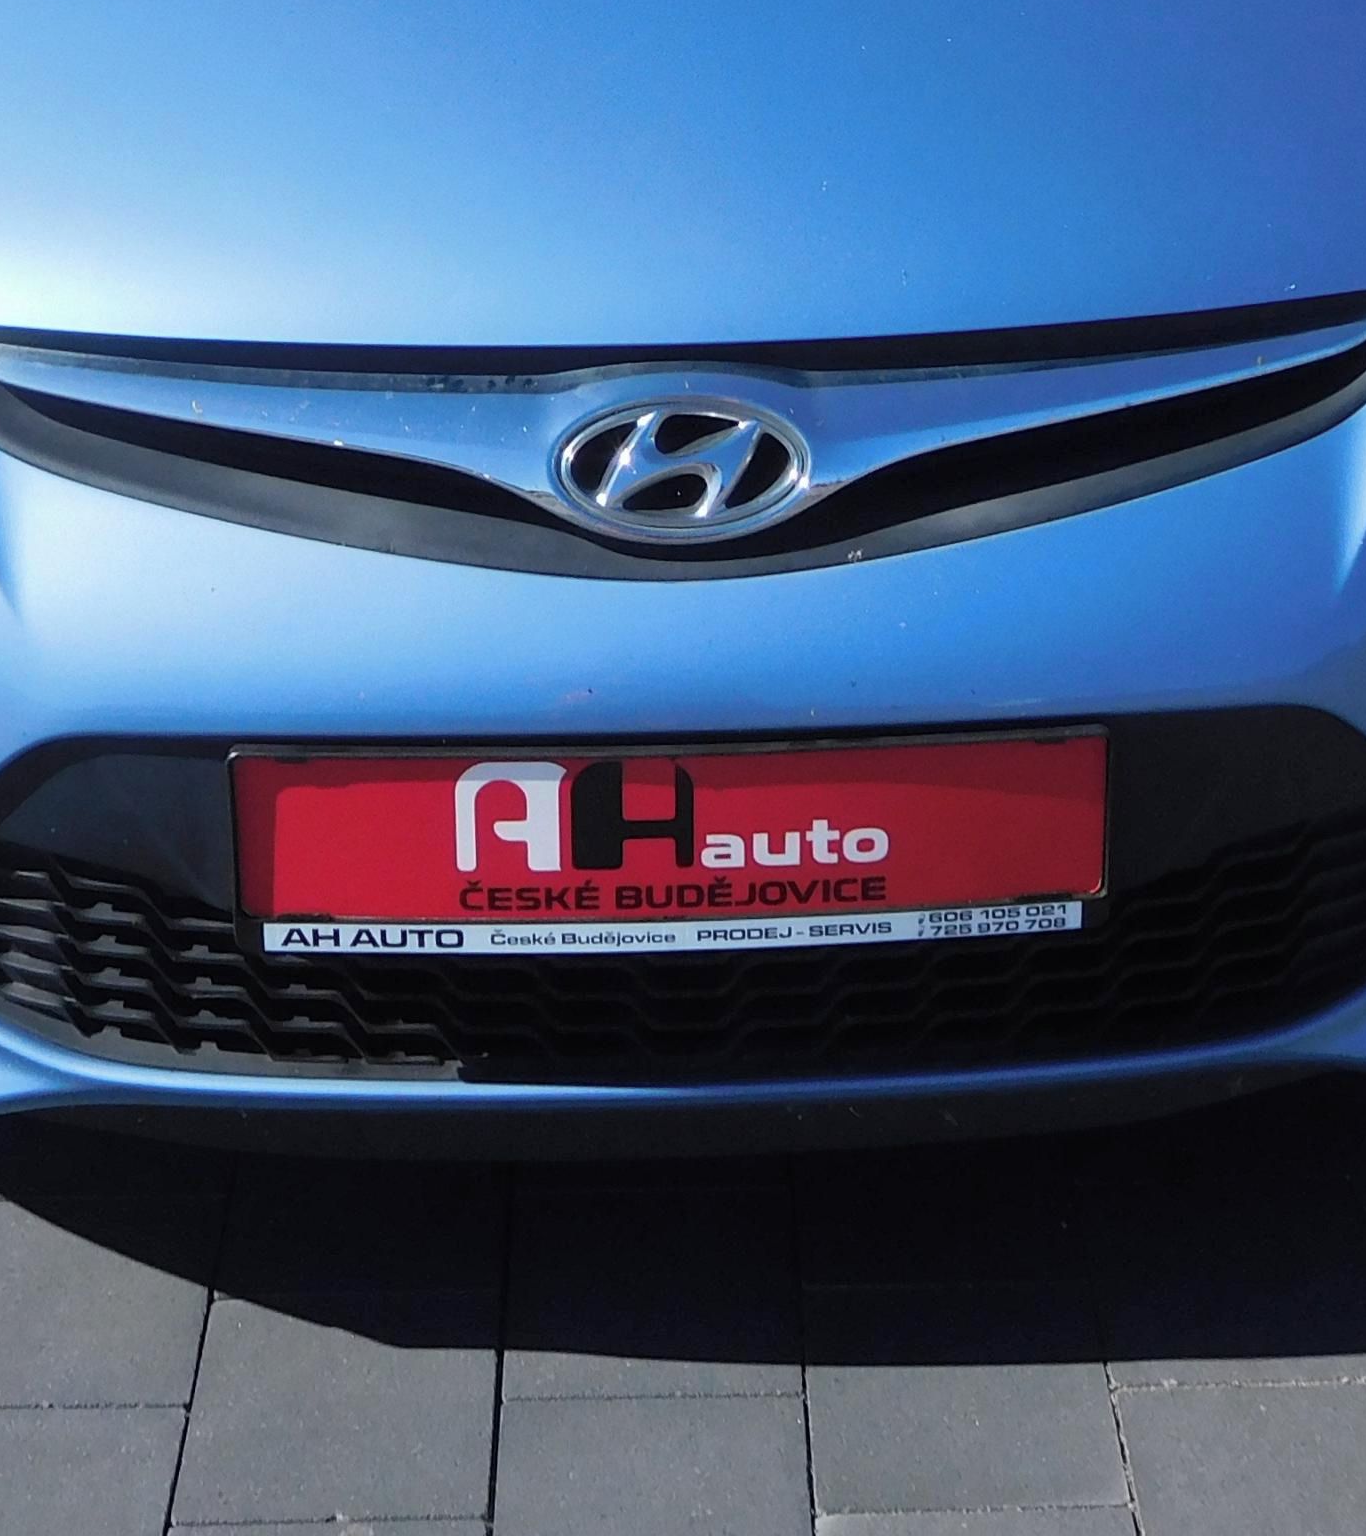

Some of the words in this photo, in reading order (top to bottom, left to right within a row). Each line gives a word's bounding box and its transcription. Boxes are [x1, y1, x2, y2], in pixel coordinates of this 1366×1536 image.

[700, 818, 890, 868] auto
[459, 880, 601, 912] ČESKÉ
[615, 875, 887, 909] BUDĚJOVICE
[281, 928, 341, 947] AH
[350, 928, 464, 948] AUTO
[490, 929, 556, 946] České
[561, 929, 676, 947] Budějovice
[697, 926, 793, 942] PRODEJ
[809, 921, 893, 937] SERVIS
